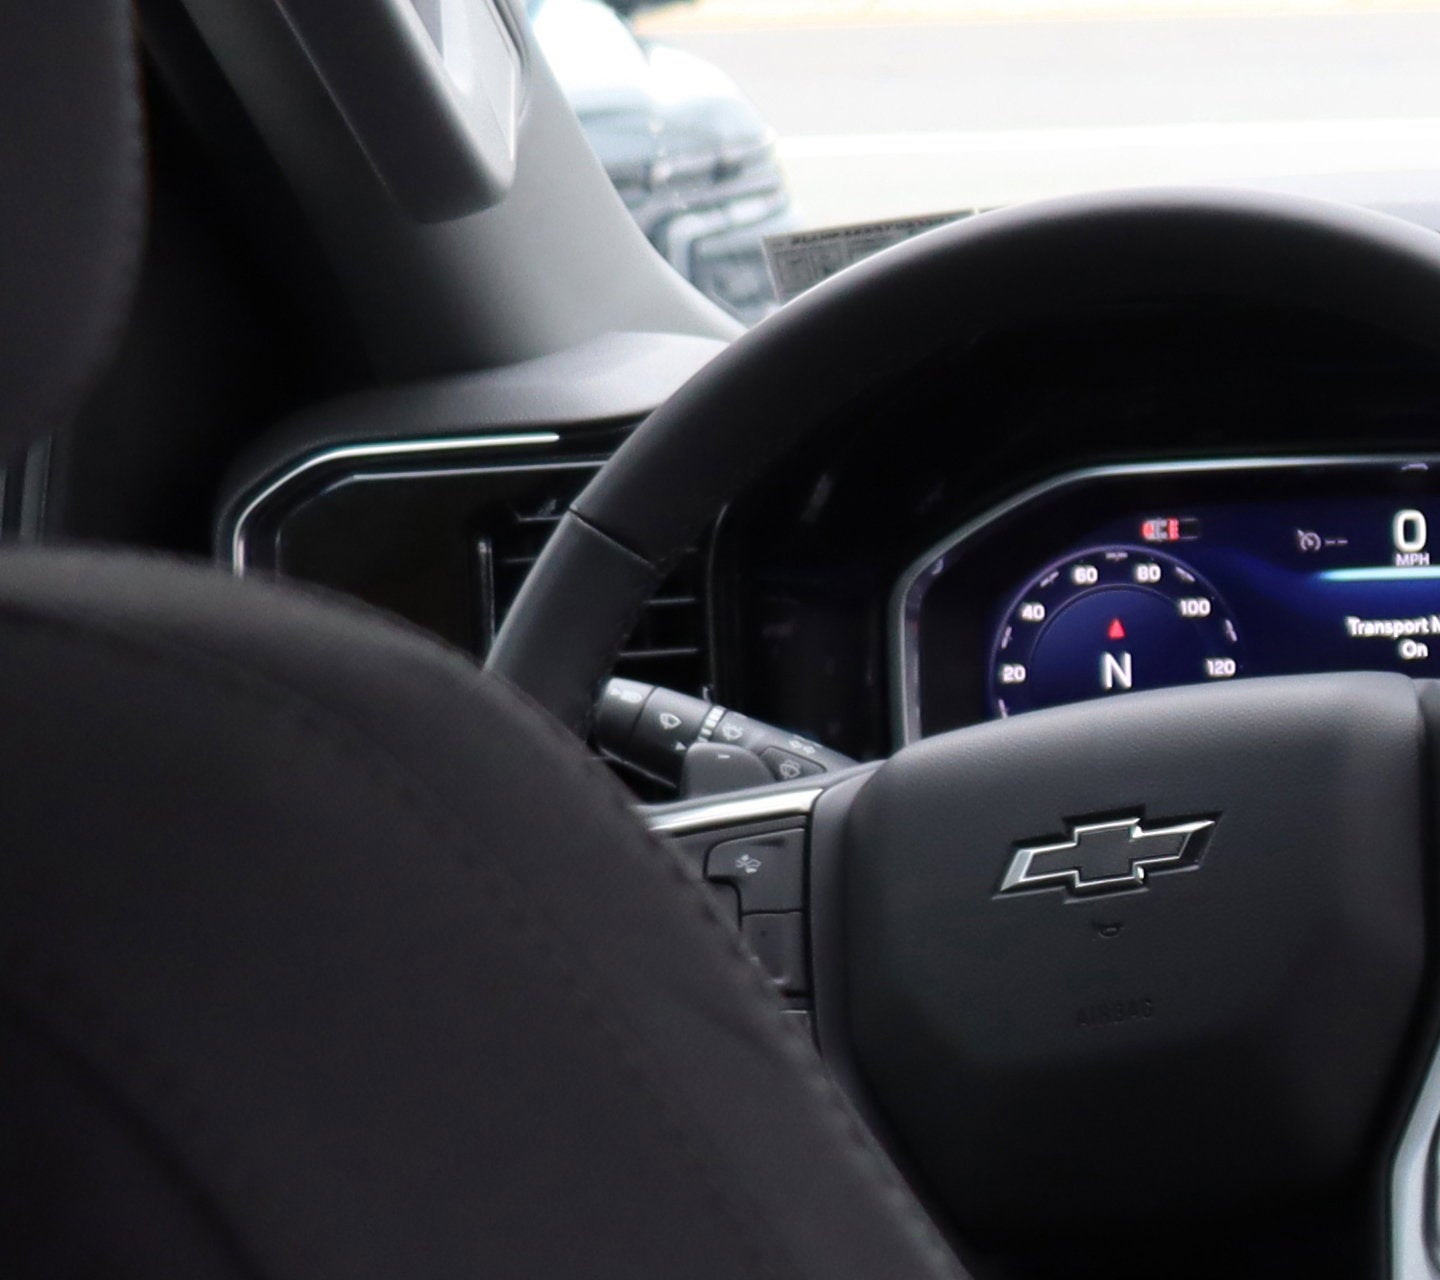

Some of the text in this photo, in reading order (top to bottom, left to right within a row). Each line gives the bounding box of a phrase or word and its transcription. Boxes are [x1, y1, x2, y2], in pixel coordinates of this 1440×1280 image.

[1395, 552, 1430, 566] MPH
[1073, 566, 1099, 585] 60
[1136, 563, 1161, 583] 80
[1020, 602, 1045, 621] 40
[1179, 598, 1210, 617] 100
[1347, 615, 1429, 640] Transport
[1399, 637, 1429, 660] On
[1003, 664, 1027, 683] 20
[1102, 651, 1132, 688] N
[1206, 659, 1236, 677] 120
